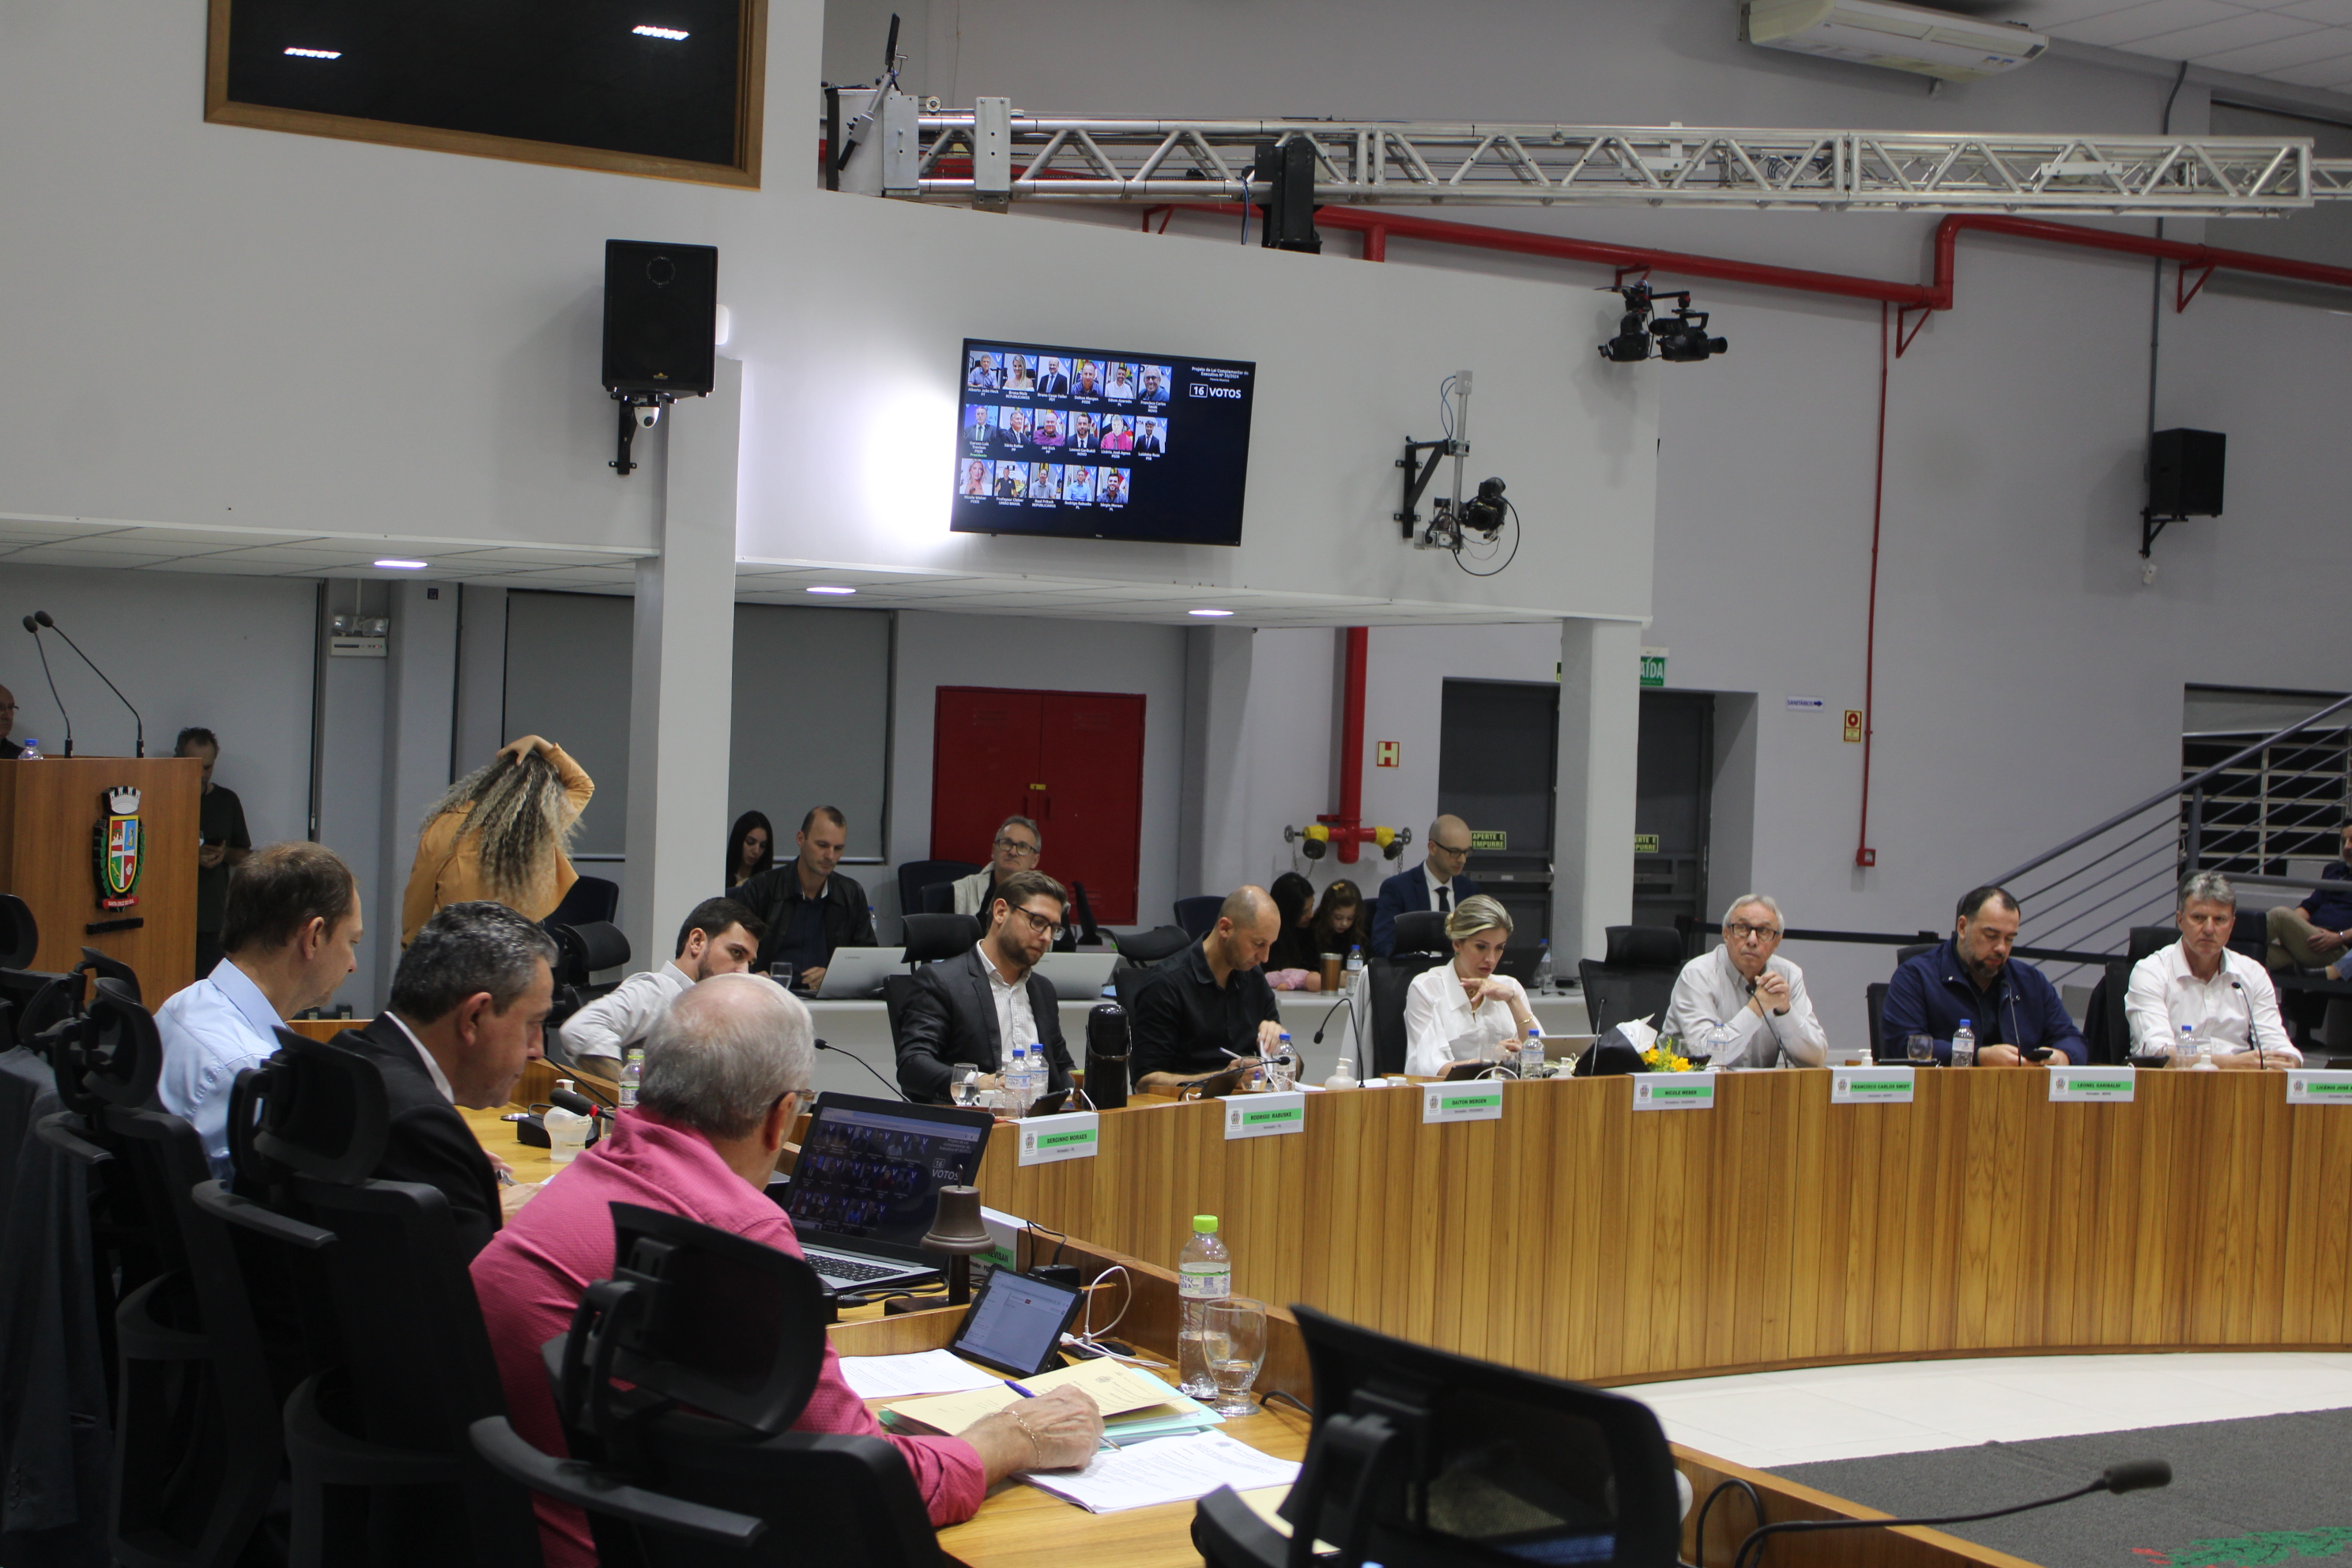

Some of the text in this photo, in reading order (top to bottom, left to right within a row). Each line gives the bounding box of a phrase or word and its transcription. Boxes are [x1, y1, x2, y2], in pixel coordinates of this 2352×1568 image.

[1193, 386, 1204, 395] 16
[1209, 387, 1242, 398] VOTOS
[1641, 657, 1664, 678] AÍDA
[933, 1169, 959, 1181] VOTOS
[985, 1250, 1008, 1263] REVISAN
